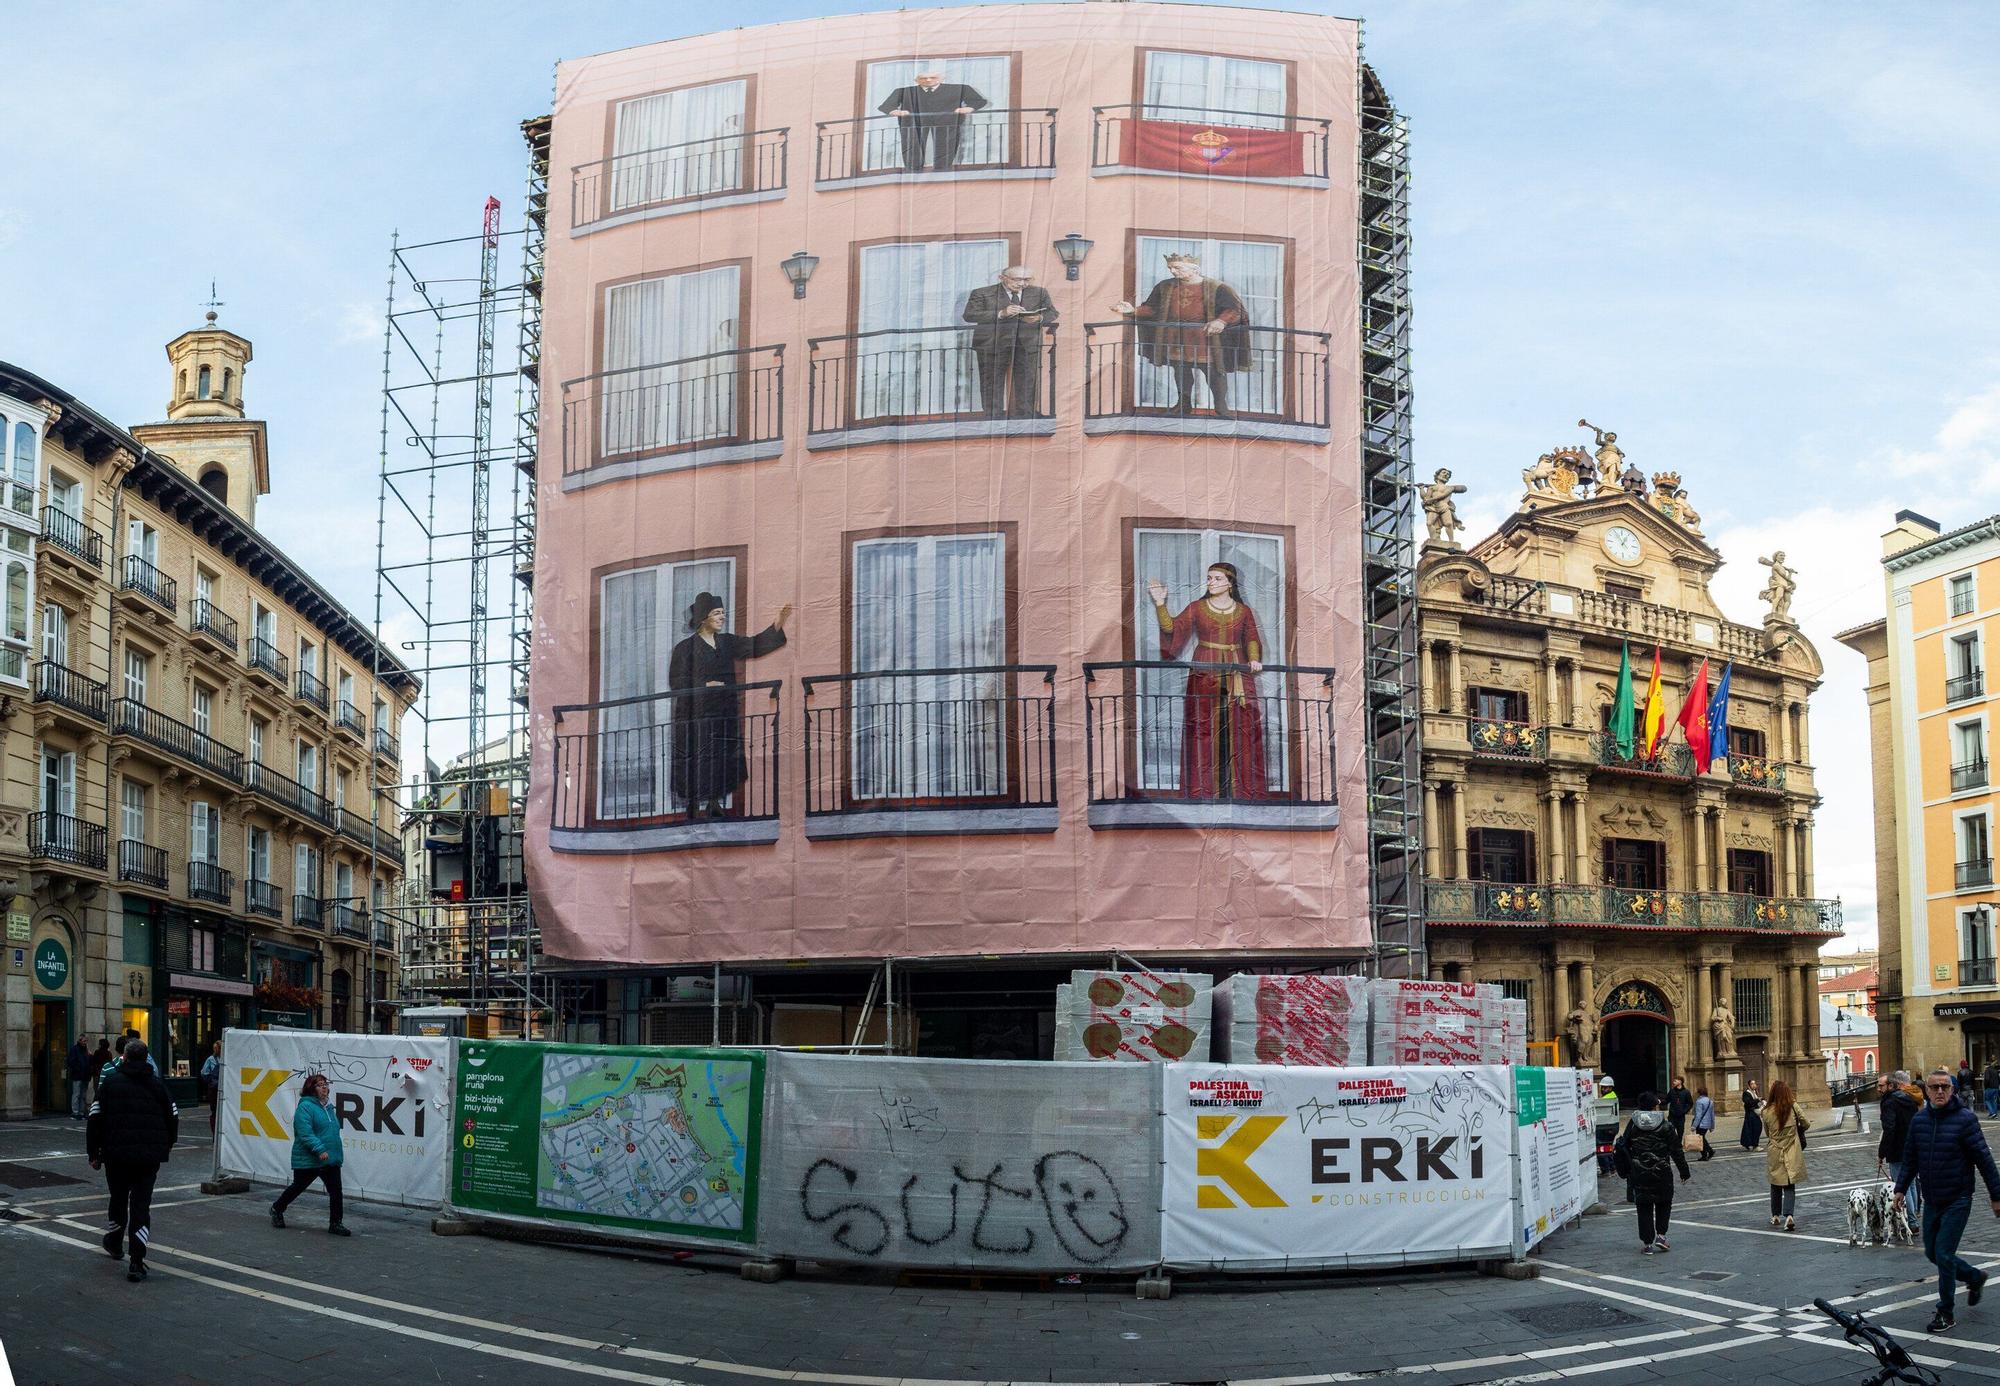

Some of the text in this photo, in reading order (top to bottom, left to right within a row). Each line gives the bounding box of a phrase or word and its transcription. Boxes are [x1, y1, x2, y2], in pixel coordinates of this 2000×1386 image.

[47, 951, 56, 960] LA
[37, 960, 66, 972] INFANTIL
[1399, 982, 1459, 993] ROCKWOOL
[1953, 1007, 1968, 1015] MOL
[1423, 1051, 1483, 1063] ROCKWOOL
[466, 1073, 504, 1082] pamplona
[465, 1081, 485, 1090] iruña
[1190, 1081, 1249, 1090] PALESTINA
[1338, 1079, 1394, 1090] PALESTINA
[1216, 1090, 1263, 1099] ASKATU!
[1363, 1087, 1407, 1098] ASKATU!
[465, 1094, 504, 1105] bizi-bizirik
[1190, 1099, 1262, 1107] ISRAELI BOIKOT
[1338, 1096, 1407, 1106] ISRAELI BOIKOT
[464, 1104, 498, 1113] muy viva
[335, 1092, 425, 1138] RKi
[342, 1137, 426, 1157] STRUCCIÓN
[1330, 1187, 1486, 1207] CONSTRUCCIÓN
